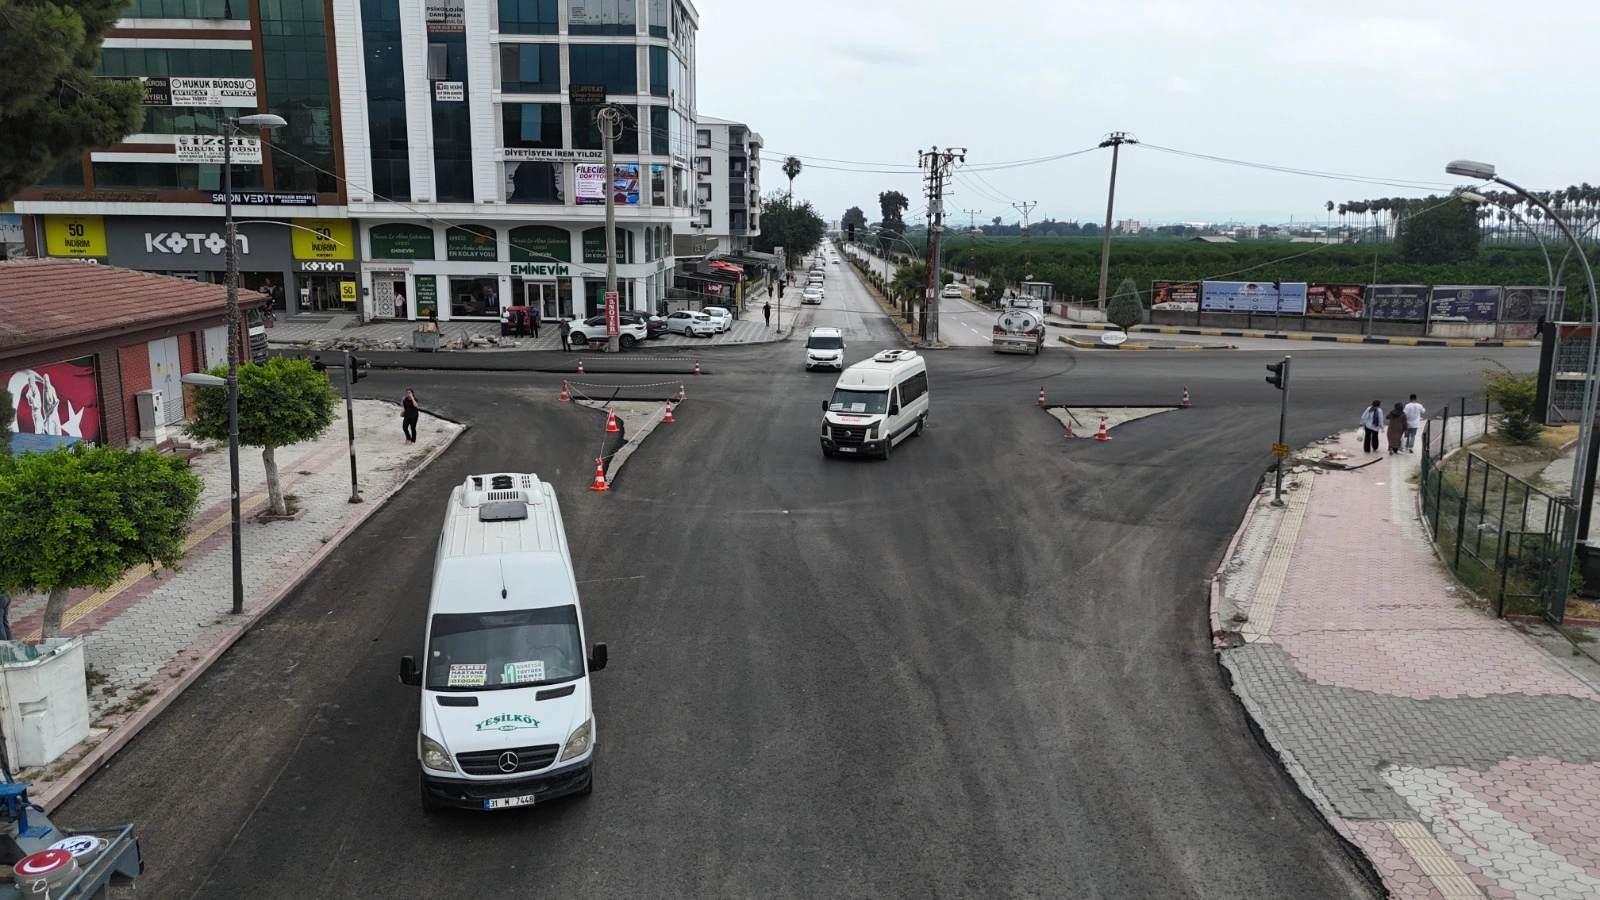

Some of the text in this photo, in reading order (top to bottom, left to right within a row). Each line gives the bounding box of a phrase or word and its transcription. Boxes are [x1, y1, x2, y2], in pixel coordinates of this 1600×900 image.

[183, 79, 244, 88] HUKUK BÜROSU
[505, 149, 552, 157] DİYETİSYEN
[65, 238, 90, 247] İNDİRİM
[145, 232, 249, 254] KOTON
[312, 242, 336, 251] İNDİRİM
[302, 262, 344, 271] KOTON
[511, 263, 568, 275] EMİNEVİM
[475, 713, 540, 730] YEŞİLKÖY
[516, 796, 534, 805] 7448
